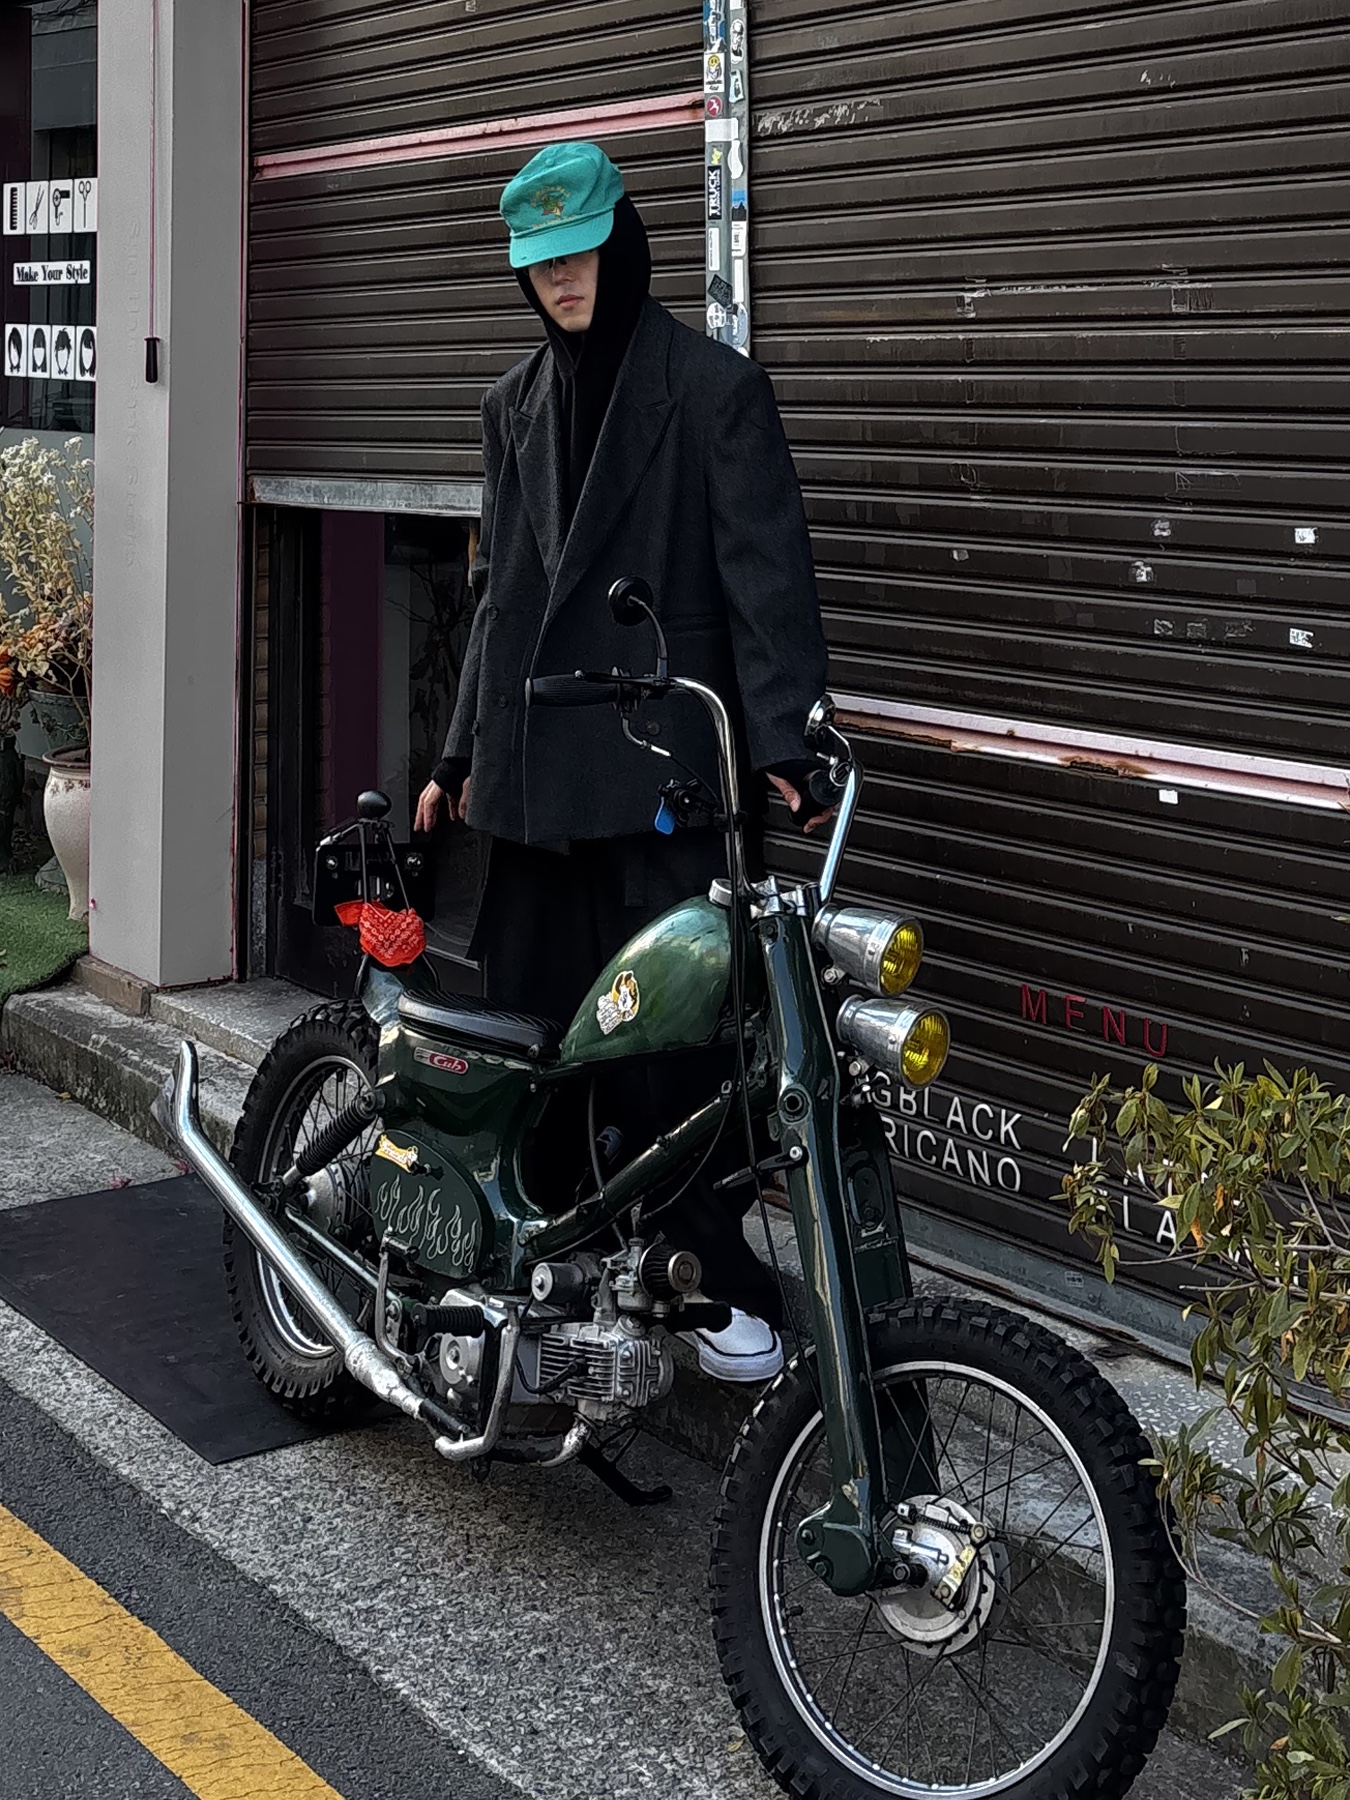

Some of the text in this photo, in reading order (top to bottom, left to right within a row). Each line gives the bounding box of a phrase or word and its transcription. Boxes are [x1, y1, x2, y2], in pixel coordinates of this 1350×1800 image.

[708, 169, 718, 217] TRUCK
[16, 263, 88, 284] Make Your Style
[1021, 984, 1167, 1057] MENU
[864, 1071, 1022, 1150] GBLACK
